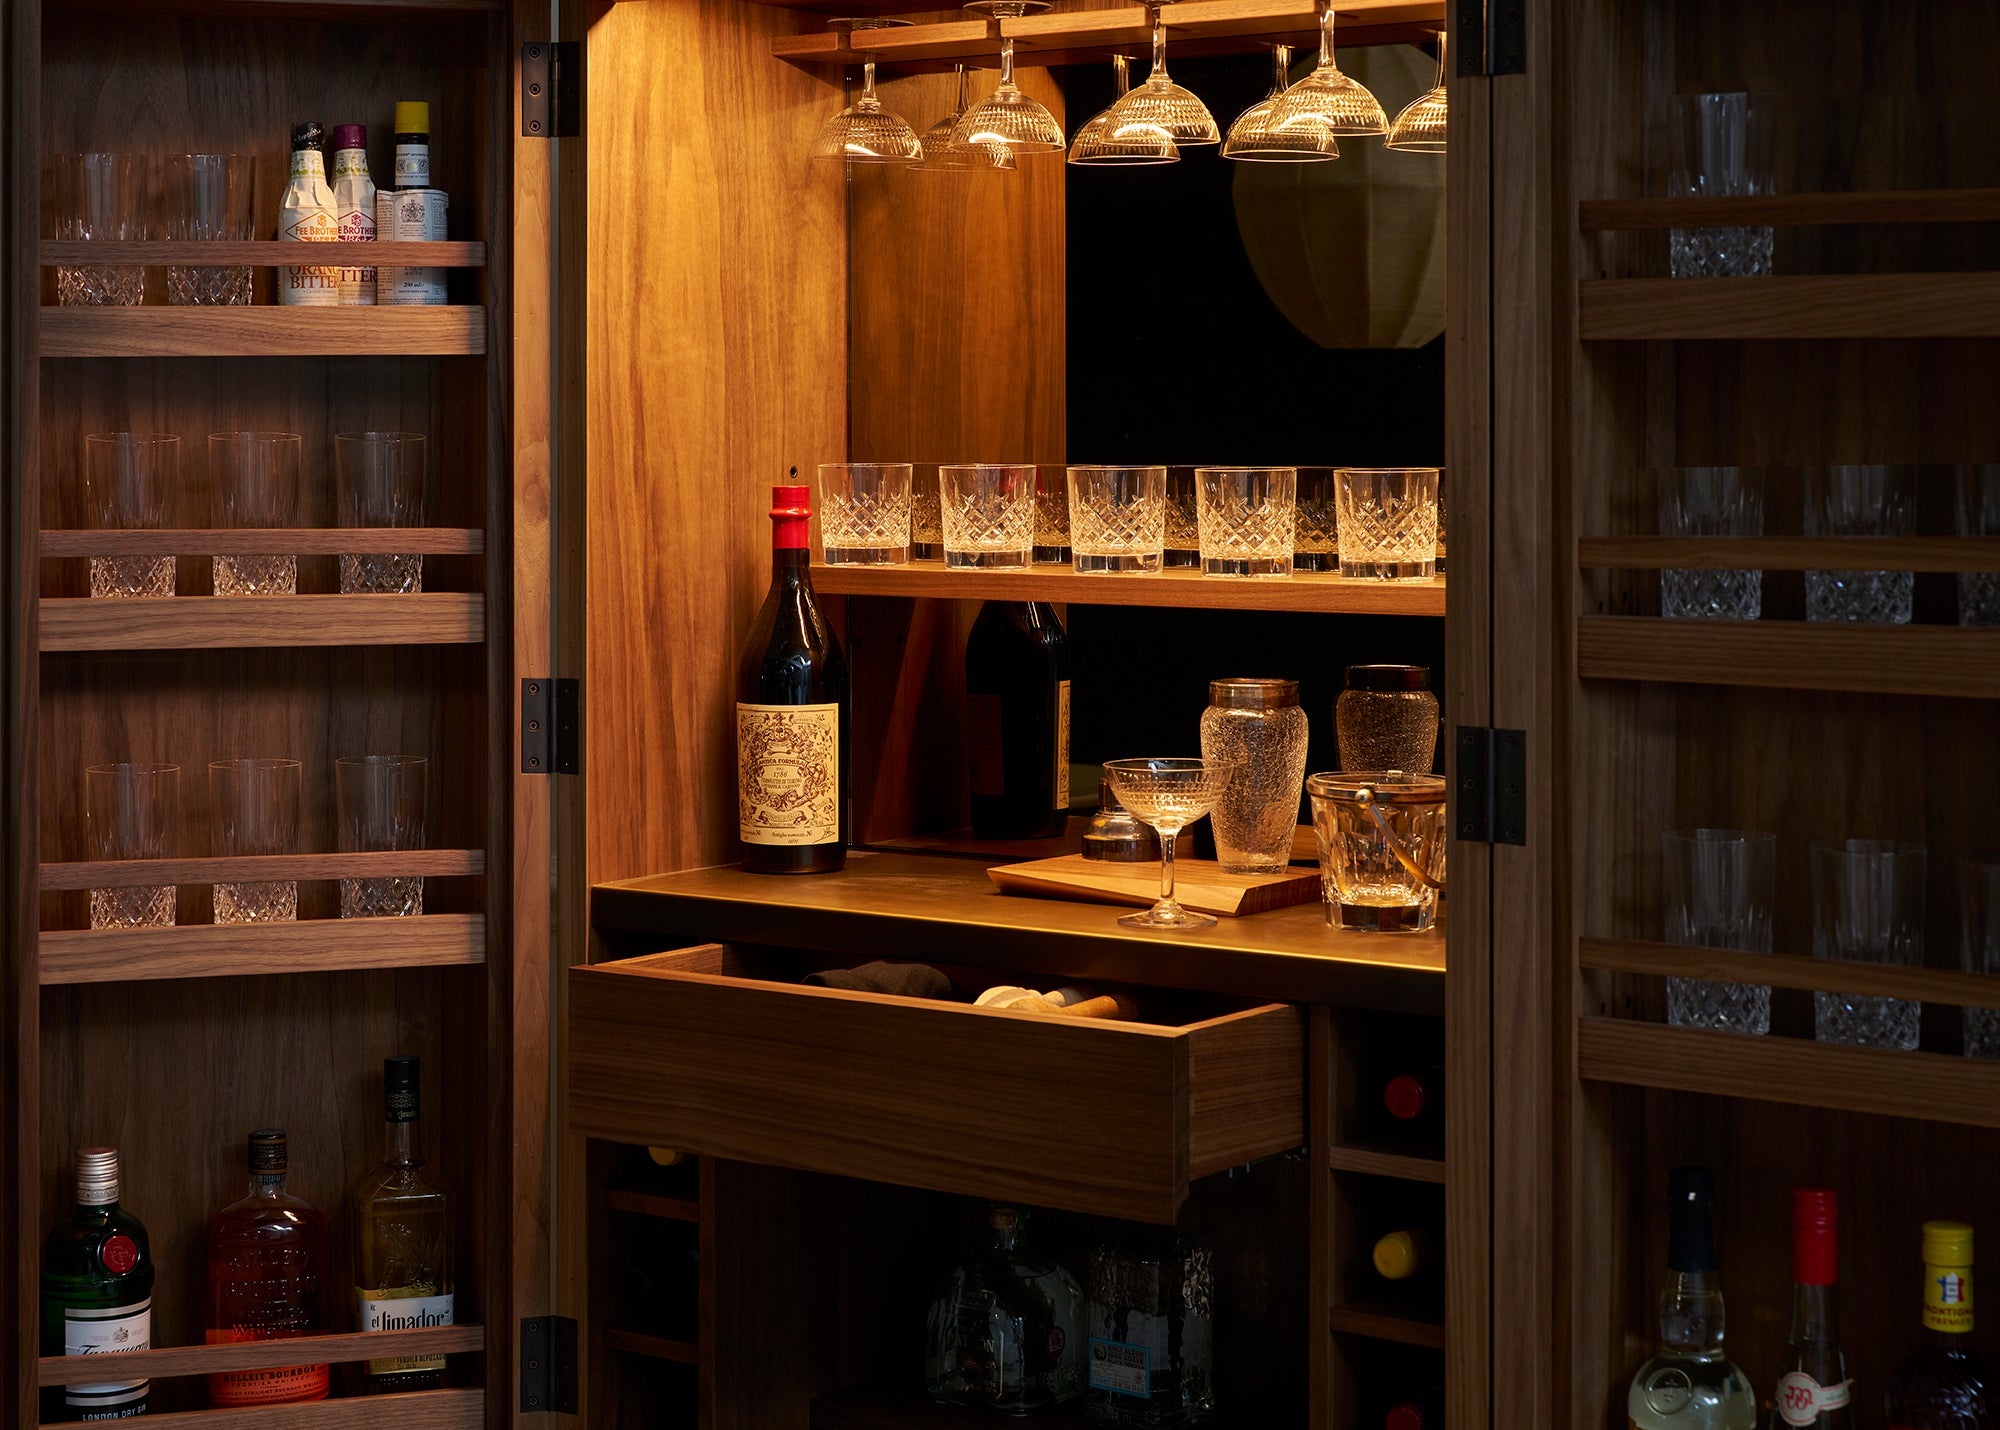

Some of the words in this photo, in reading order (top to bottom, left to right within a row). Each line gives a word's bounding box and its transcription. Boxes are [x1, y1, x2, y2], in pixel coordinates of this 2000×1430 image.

[296, 226, 308, 235] FEE
[778, 758, 805, 766] FORMULA
[372, 1316, 380, 1328] el
[224, 1373, 265, 1382] BULLEIT
[269, 1365, 316, 1379] BOURBON
[82, 1411, 120, 1421] LONDON
[121, 1407, 137, 1418] DRY
